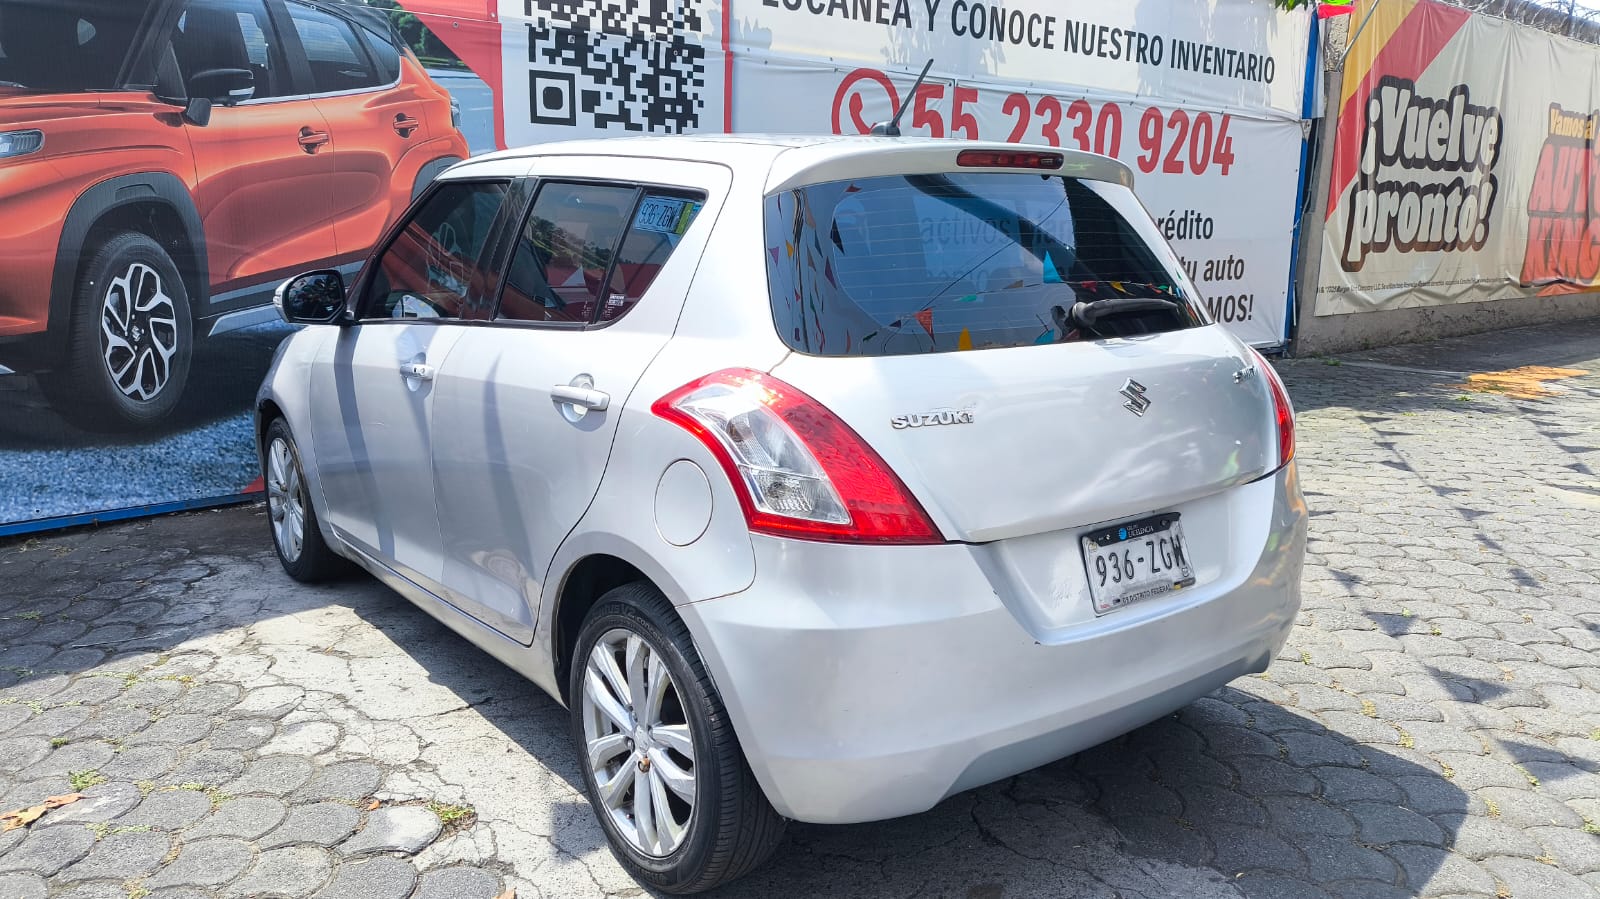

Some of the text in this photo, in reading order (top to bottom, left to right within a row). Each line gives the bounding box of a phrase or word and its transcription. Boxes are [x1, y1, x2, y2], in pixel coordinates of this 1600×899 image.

[926, 0, 940, 31] Y
[951, 0, 1056, 49] CONOCE
[1063, 19, 1164, 66] NUESTRO
[1170, 39, 1275, 84] INVENTARIO
[912, 83, 1234, 175] 55 2330 9204
[1359, 80, 1500, 175] ¡Vuelve
[1550, 109, 1597, 139] Vamos al
[1528, 143, 1600, 213] AUT
[1157, 209, 1214, 240] rédito
[1346, 181, 1494, 263] pronto!
[1203, 255, 1244, 281] auto
[891, 411, 974, 429] SUZUKI
[1096, 534, 1185, 587] 936-ZGW
